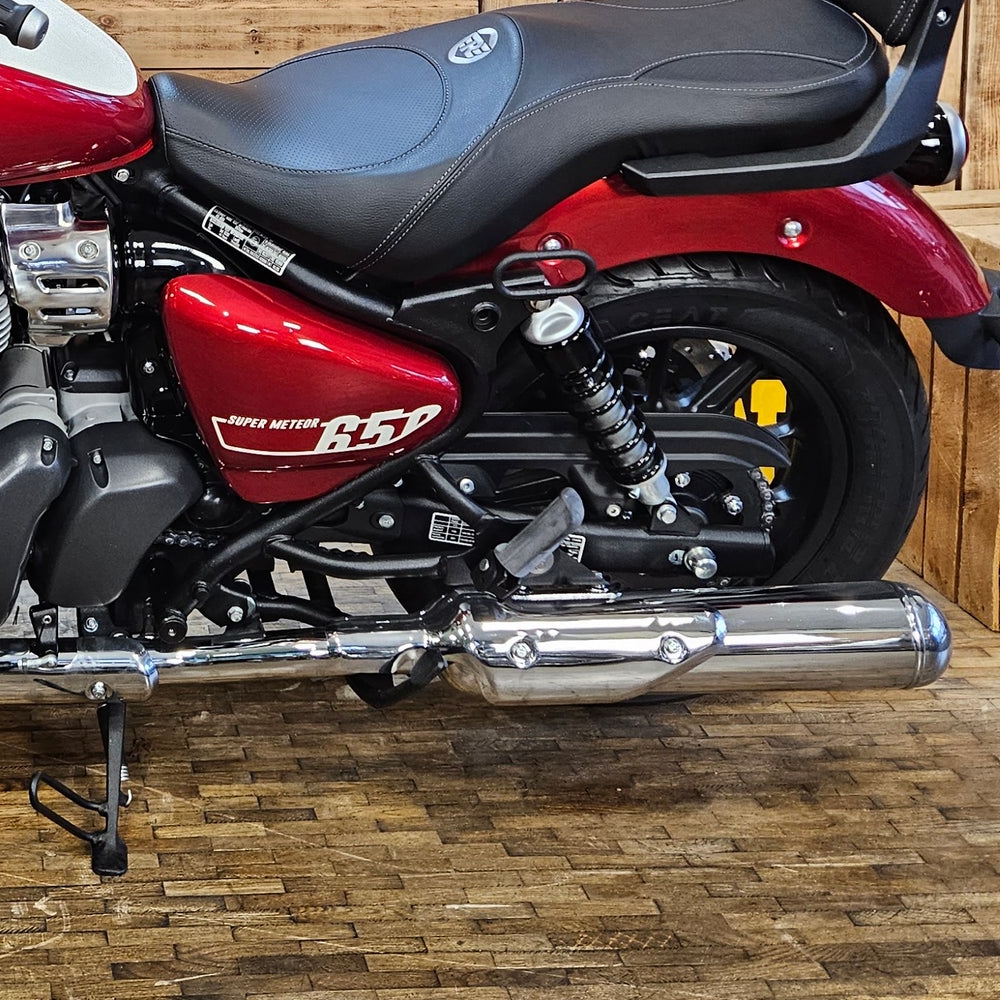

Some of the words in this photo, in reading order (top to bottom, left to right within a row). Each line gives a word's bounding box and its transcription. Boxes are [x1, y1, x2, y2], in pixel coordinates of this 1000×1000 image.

[227, 415, 268, 429] SUPER
[269, 418, 320, 430] METEOR
[314, 404, 442, 453] 650
